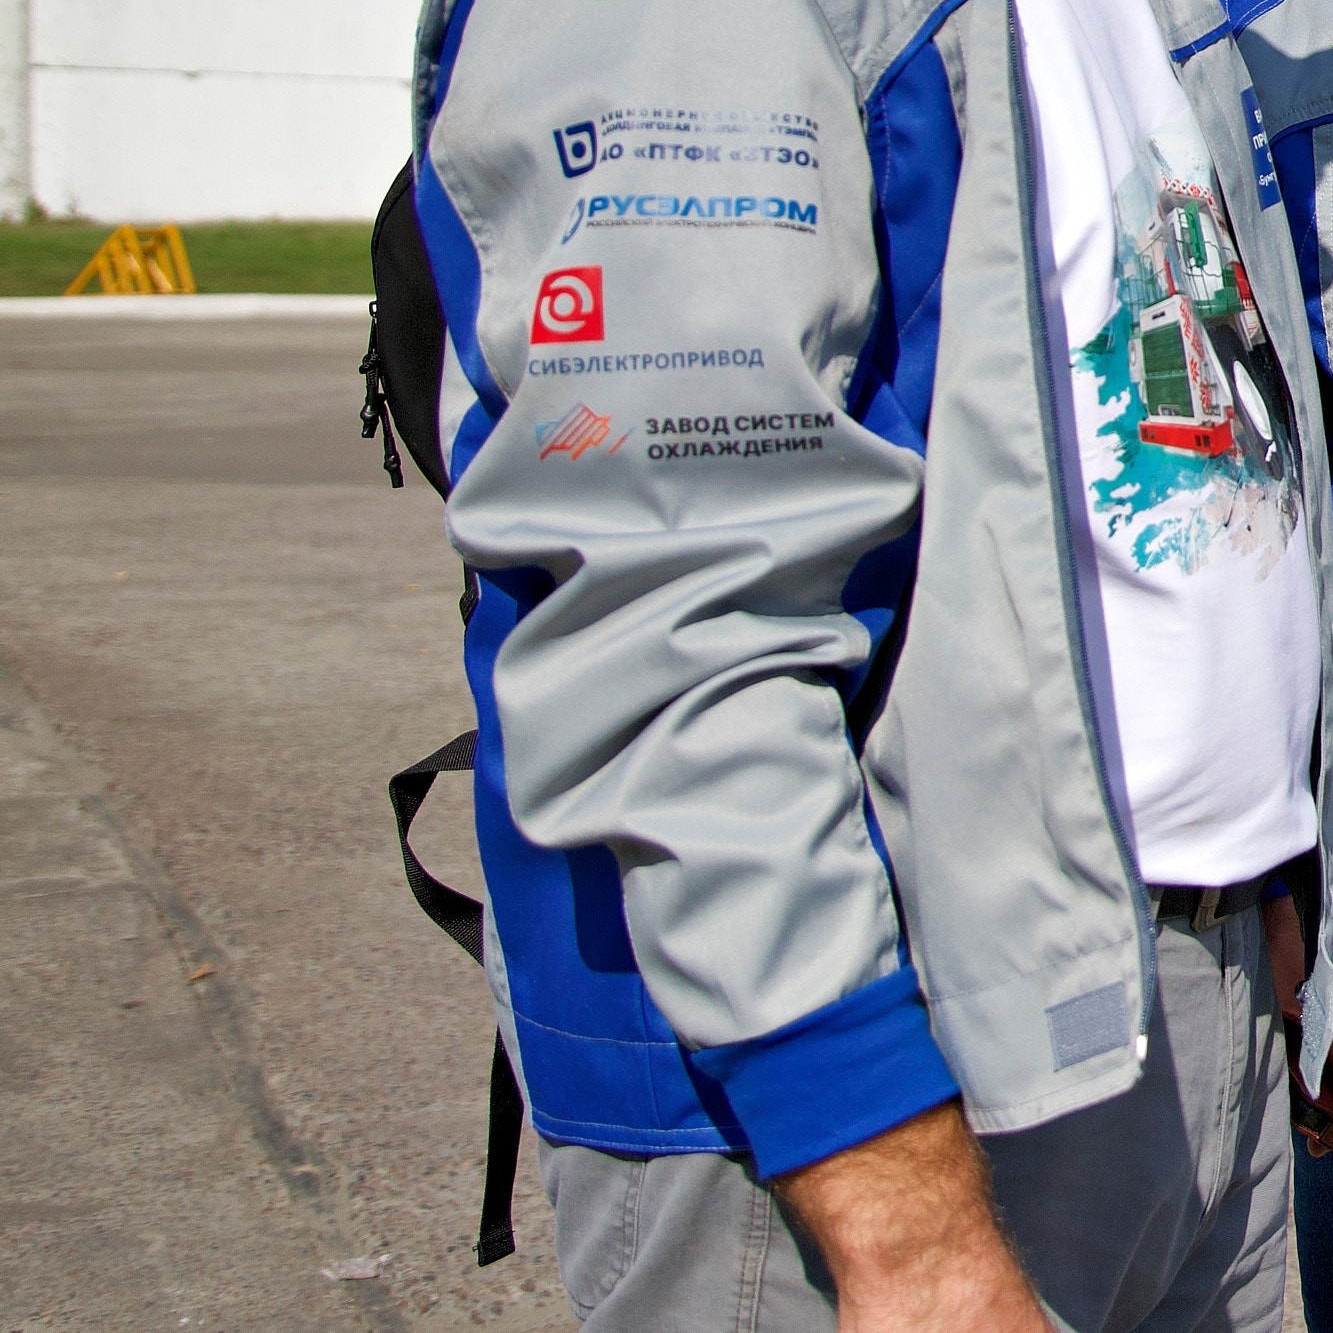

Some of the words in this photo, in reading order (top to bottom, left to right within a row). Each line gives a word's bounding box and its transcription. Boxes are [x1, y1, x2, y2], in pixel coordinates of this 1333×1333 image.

[588, 195, 817, 225] РУСЭЛПРОМ
[528, 348, 764, 377] СИБЭЛЕКТРОПРИВОД
[646, 416, 730, 436] ЗАВОД
[735, 411, 835, 432] СИСТЕМ
[648, 435, 824, 460] ОХЛАЖДЕНИЯ
